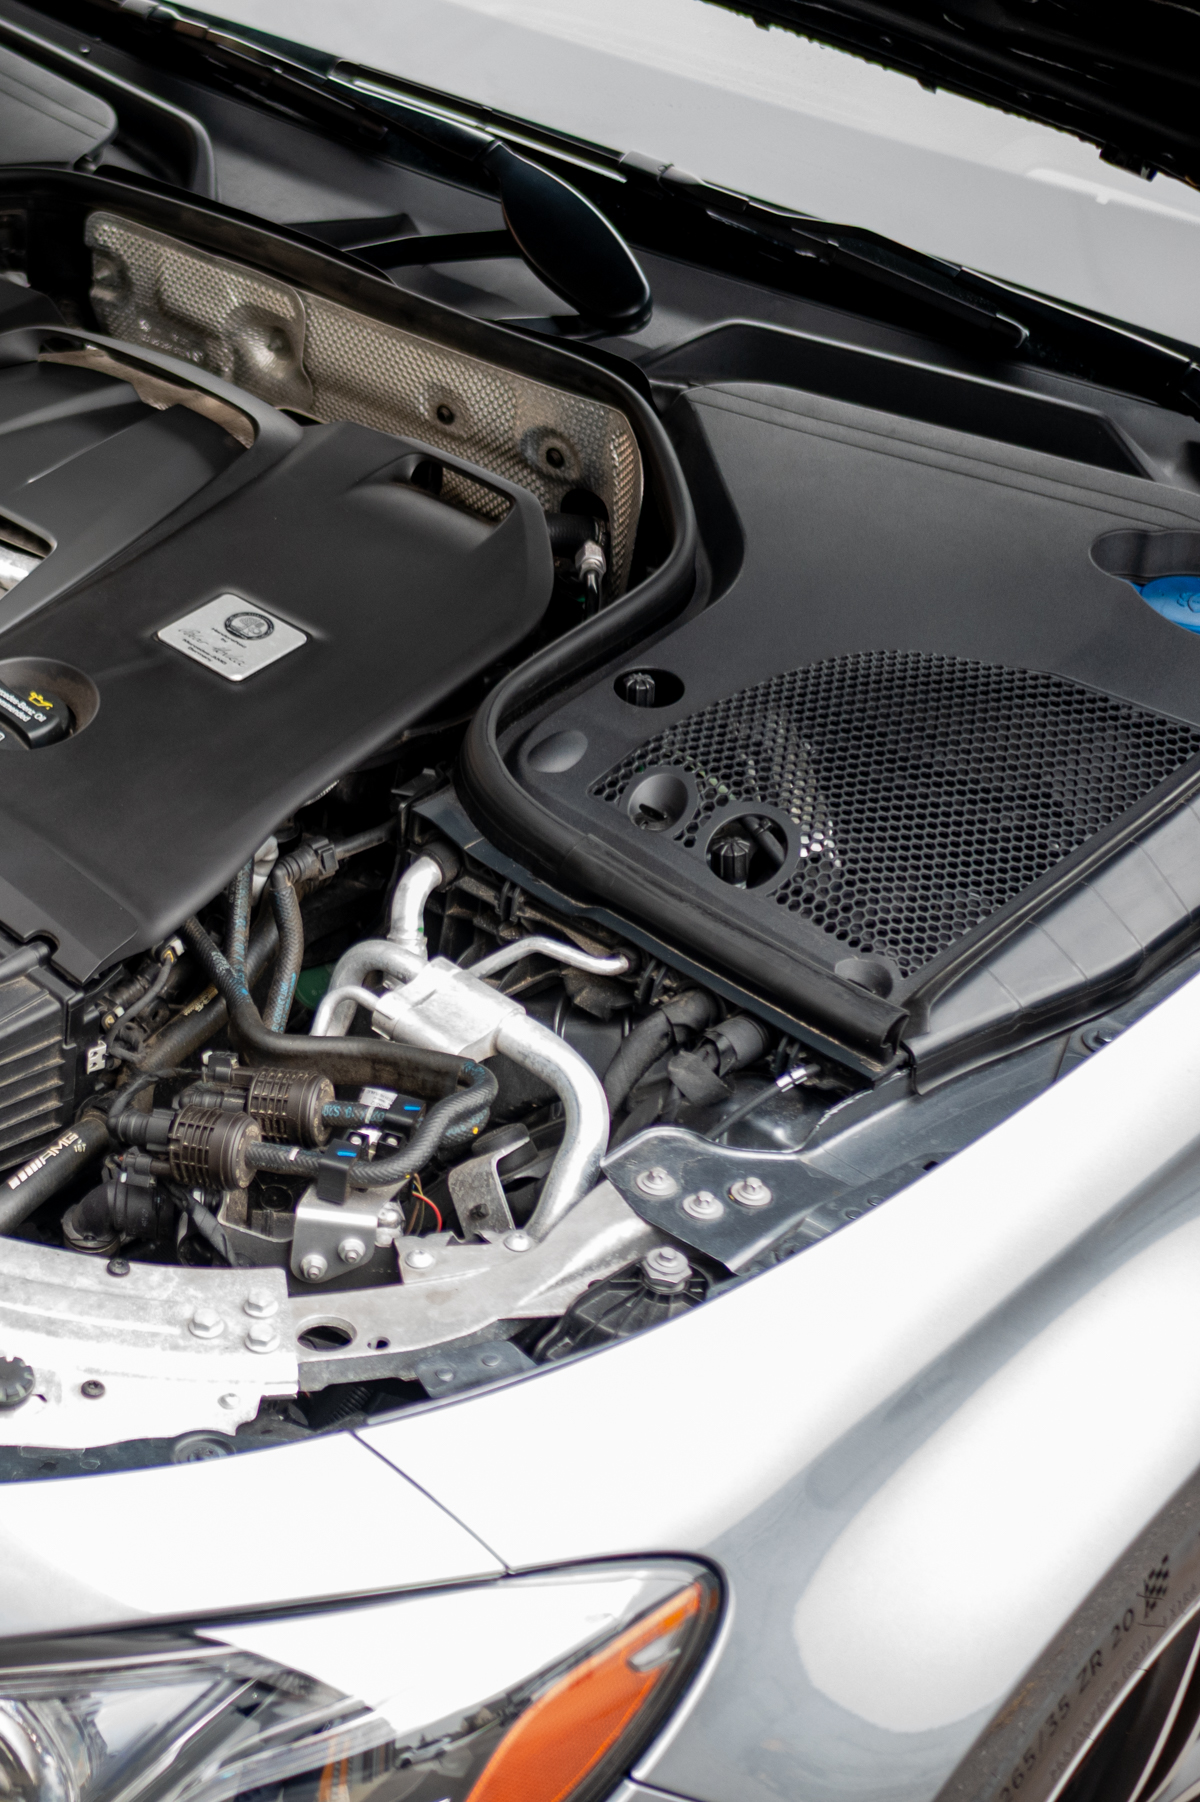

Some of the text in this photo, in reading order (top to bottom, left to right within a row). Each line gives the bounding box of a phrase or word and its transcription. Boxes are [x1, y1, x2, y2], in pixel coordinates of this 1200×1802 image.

[33, 711, 47, 723] Oil
[39, 1131, 79, 1166] AMG
[1076, 1649, 1103, 1695] ZR
[1111, 1607, 1135, 1650] 20
